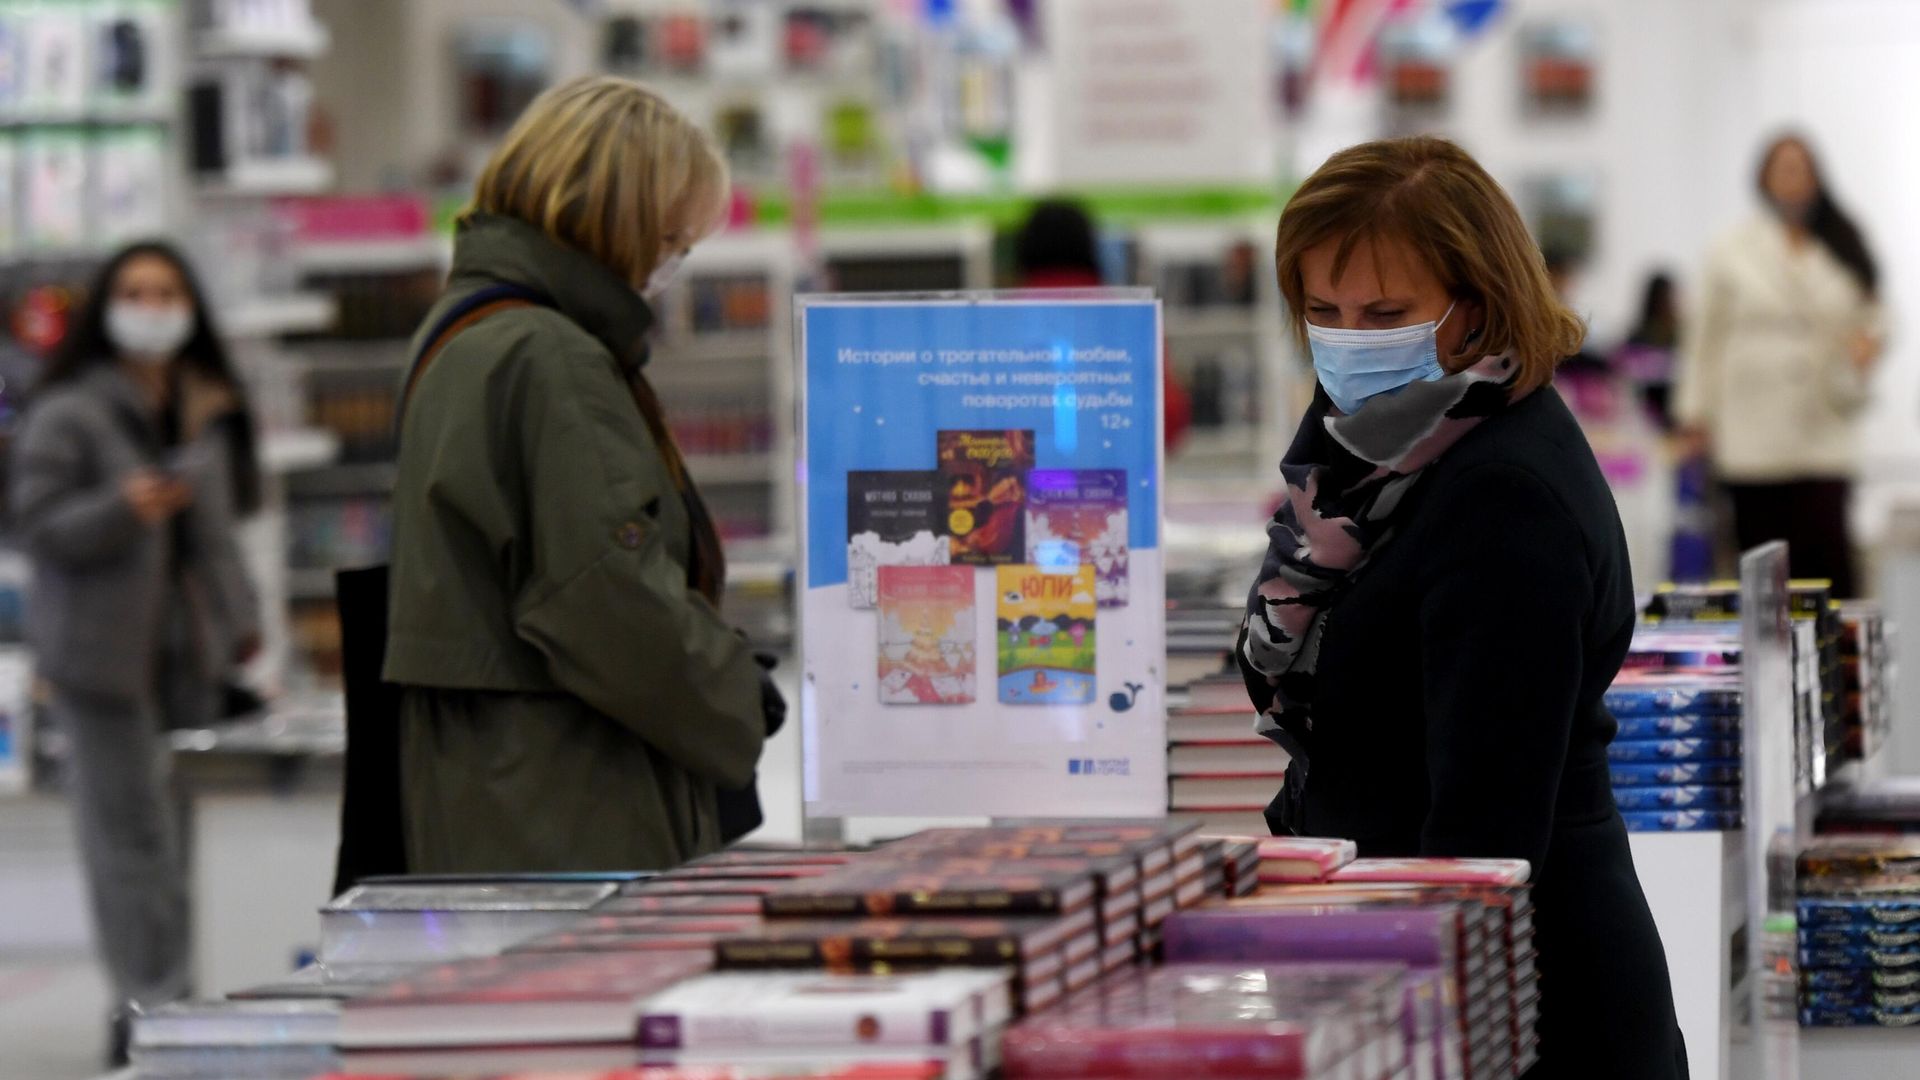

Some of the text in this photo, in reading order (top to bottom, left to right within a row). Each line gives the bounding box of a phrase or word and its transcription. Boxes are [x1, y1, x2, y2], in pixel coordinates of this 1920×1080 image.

[837, 348, 917, 366] Истории
[920, 351, 934, 364] о
[938, 346, 1063, 366] трогательной
[917, 372, 1133, 387] счастье и невероятных
[1065, 389, 1133, 410] судьбы
[1101, 414, 1132, 430] 12+
